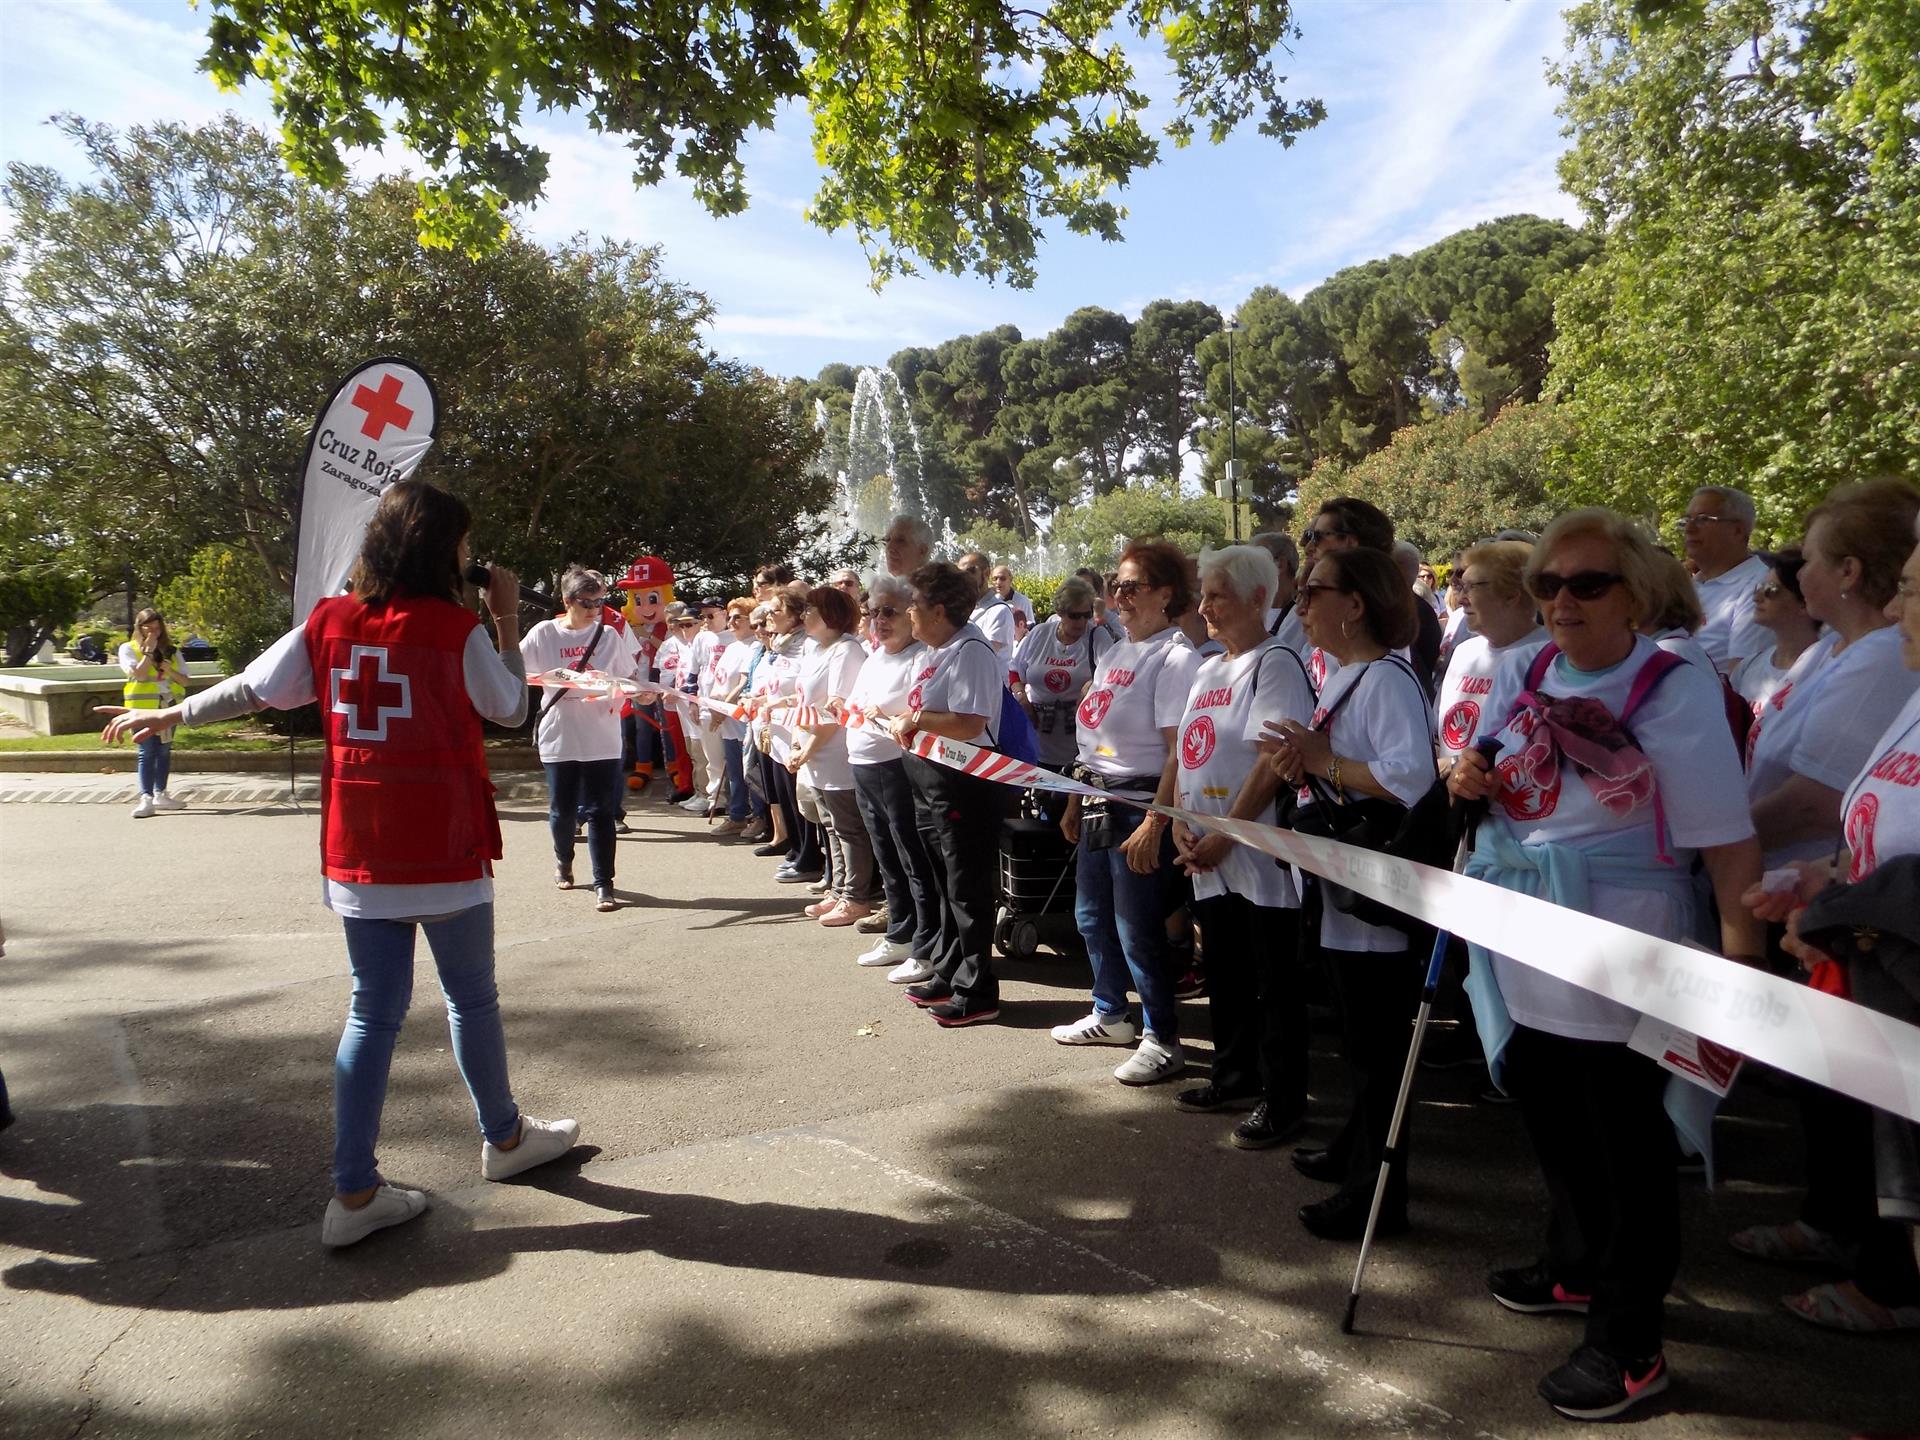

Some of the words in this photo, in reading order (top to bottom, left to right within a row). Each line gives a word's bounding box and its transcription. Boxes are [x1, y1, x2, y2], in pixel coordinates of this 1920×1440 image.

[319, 429, 360, 464] Cruz
[361, 448, 401, 484] Roja
[321, 461, 381, 497] Zaragoza
